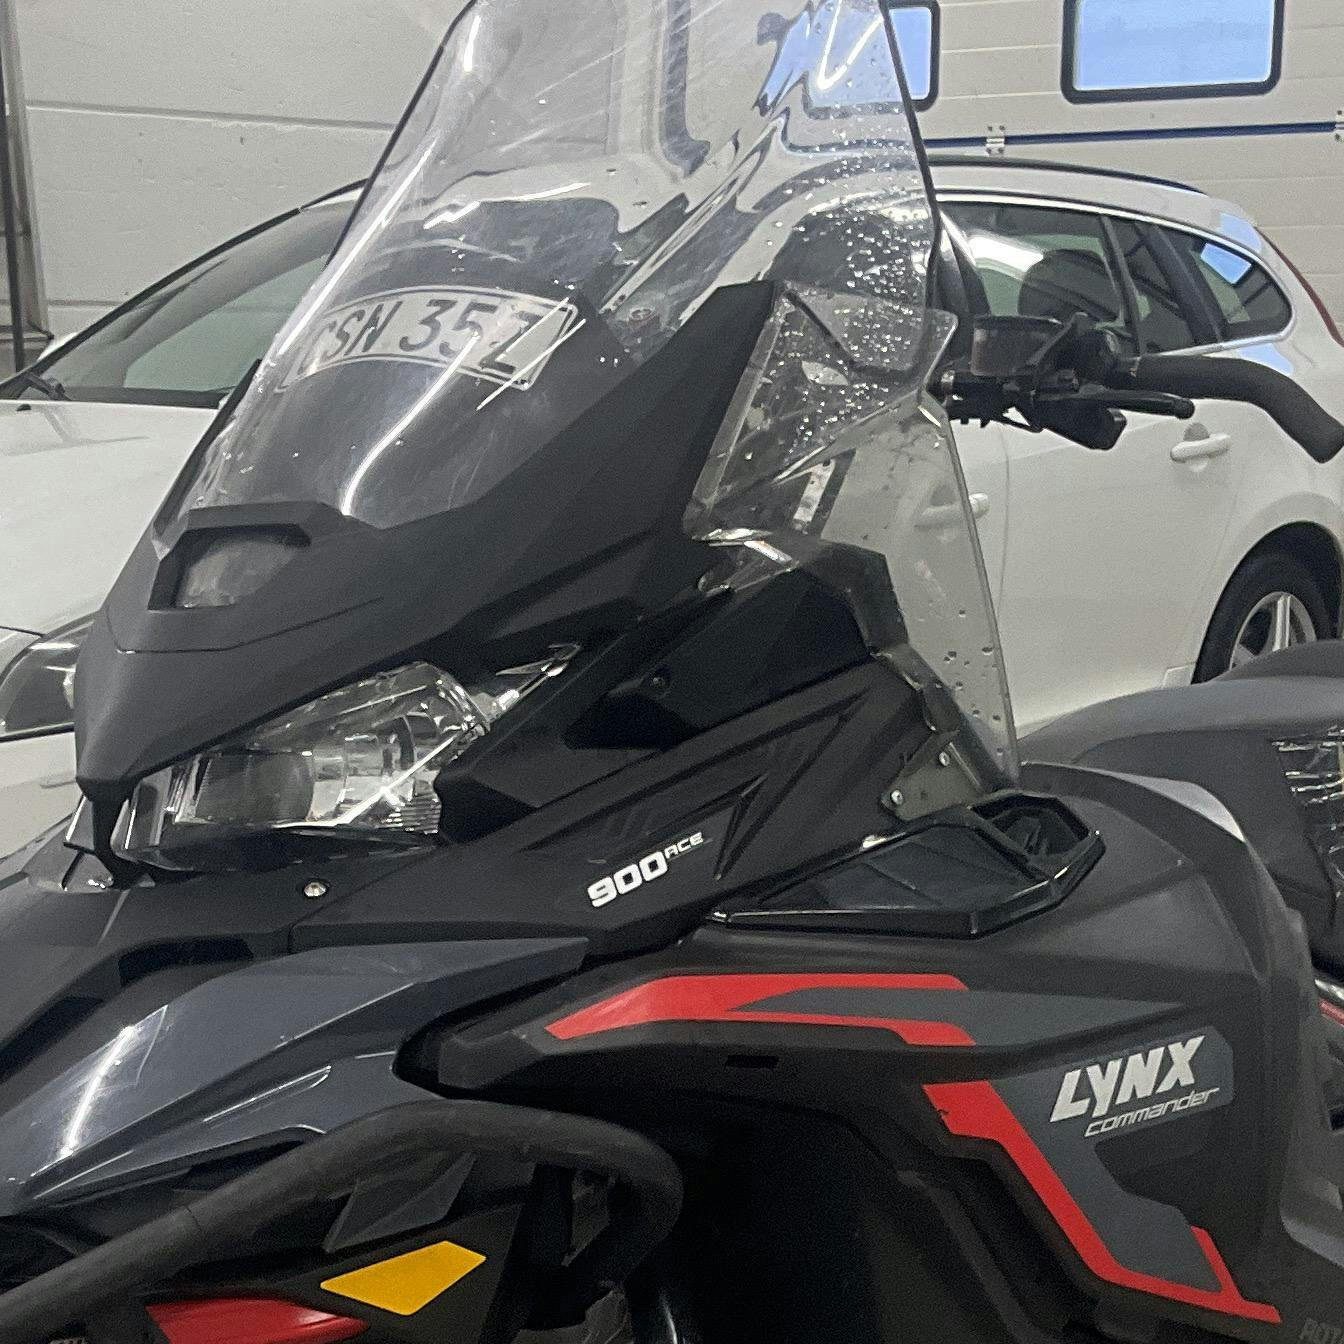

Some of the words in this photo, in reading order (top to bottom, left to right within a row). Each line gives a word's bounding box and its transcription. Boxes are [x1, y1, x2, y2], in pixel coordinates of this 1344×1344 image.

[587, 851, 668, 908] 900
[664, 831, 704, 860] ACE
[1050, 1035, 1206, 1123] LYNX
[1084, 1087, 1220, 1138] commander
